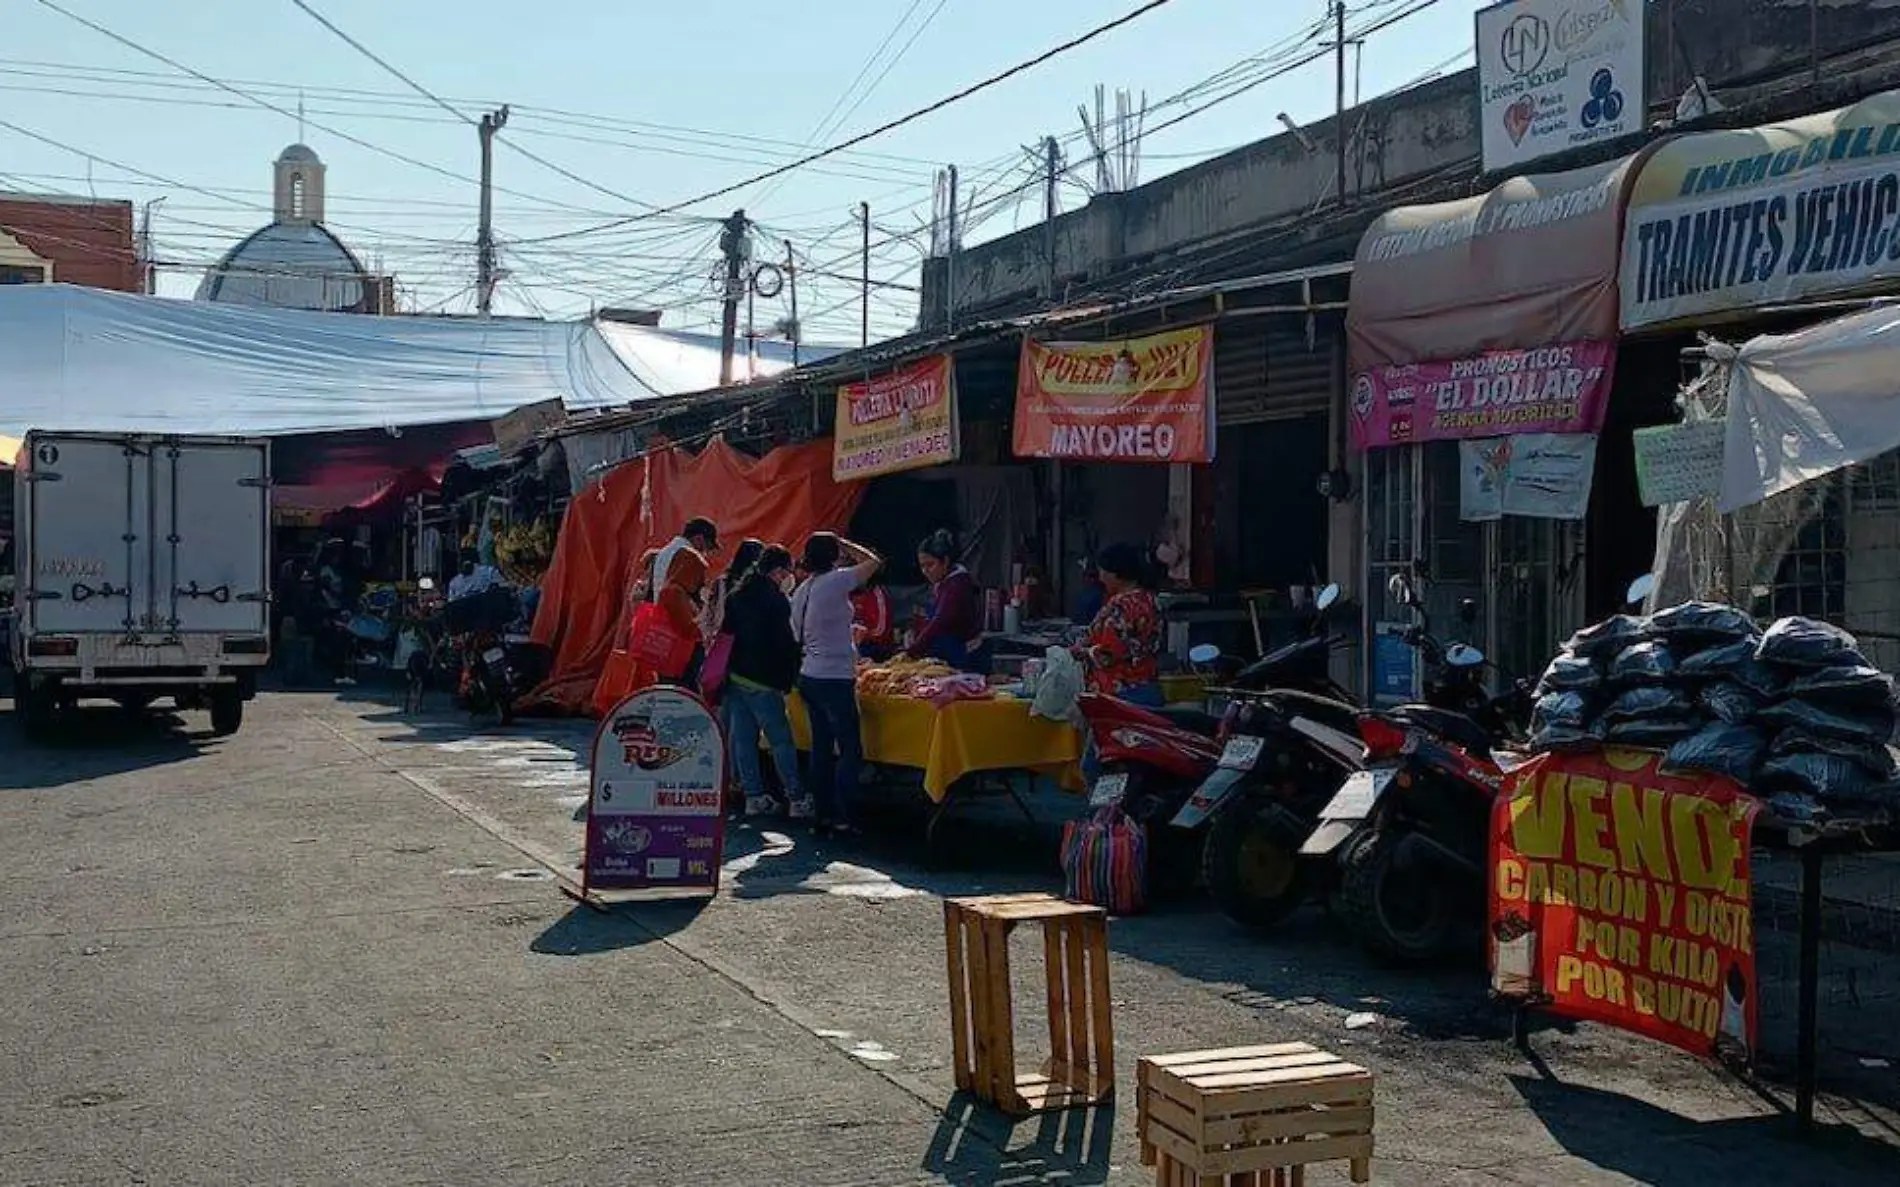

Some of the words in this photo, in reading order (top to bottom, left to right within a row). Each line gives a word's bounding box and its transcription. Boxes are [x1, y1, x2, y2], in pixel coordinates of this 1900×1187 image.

[1637, 195, 1787, 303] TRAMITES
[1051, 423, 1175, 458] MAYOREO
[1654, 881, 1676, 928] Y
[1576, 915, 1641, 967] POR
[1650, 931, 1719, 988] KILO
[1555, 955, 1626, 1007] POR
[1631, 974, 1719, 1040] BULTO
